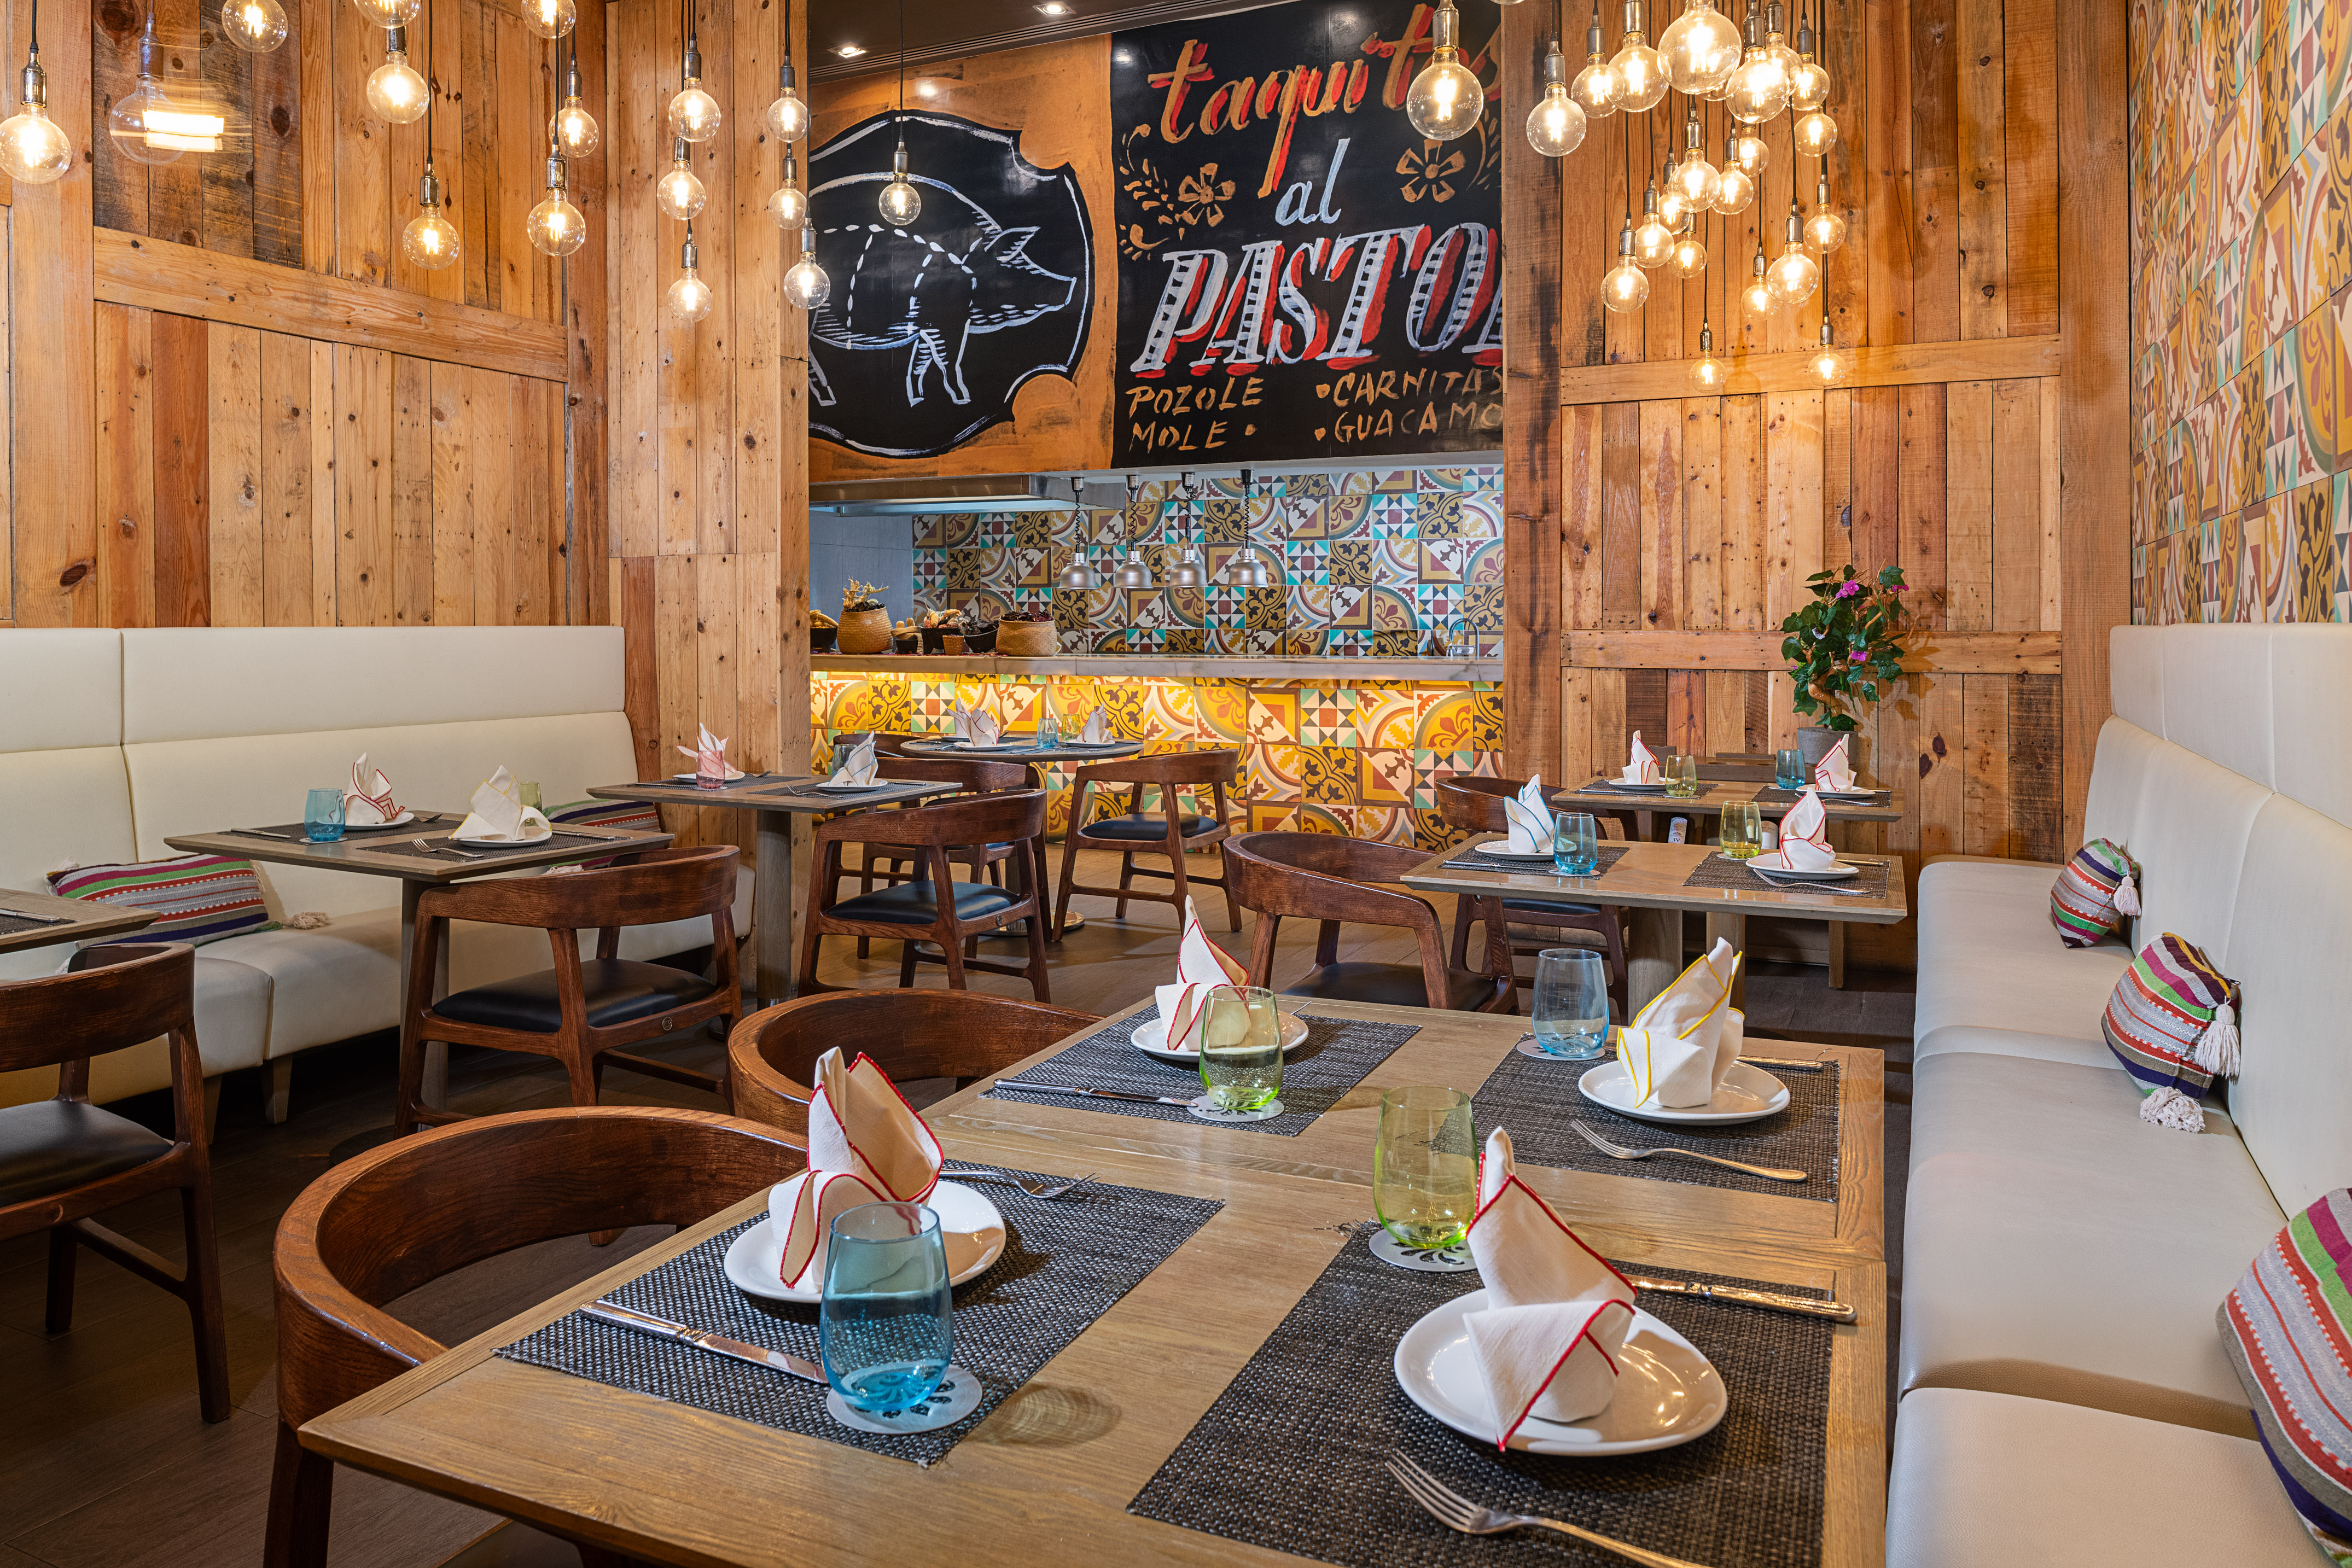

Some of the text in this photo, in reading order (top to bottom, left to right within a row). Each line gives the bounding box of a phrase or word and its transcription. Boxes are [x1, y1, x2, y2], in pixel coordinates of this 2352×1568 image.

[1148, 4, 1503, 198] taquits
[1275, 138, 1350, 226] al
[1125, 378, 1264, 417] POZOLE
[1128, 420, 1227, 453] MOLE
[1335, 401, 1503, 443] GUACAMO
